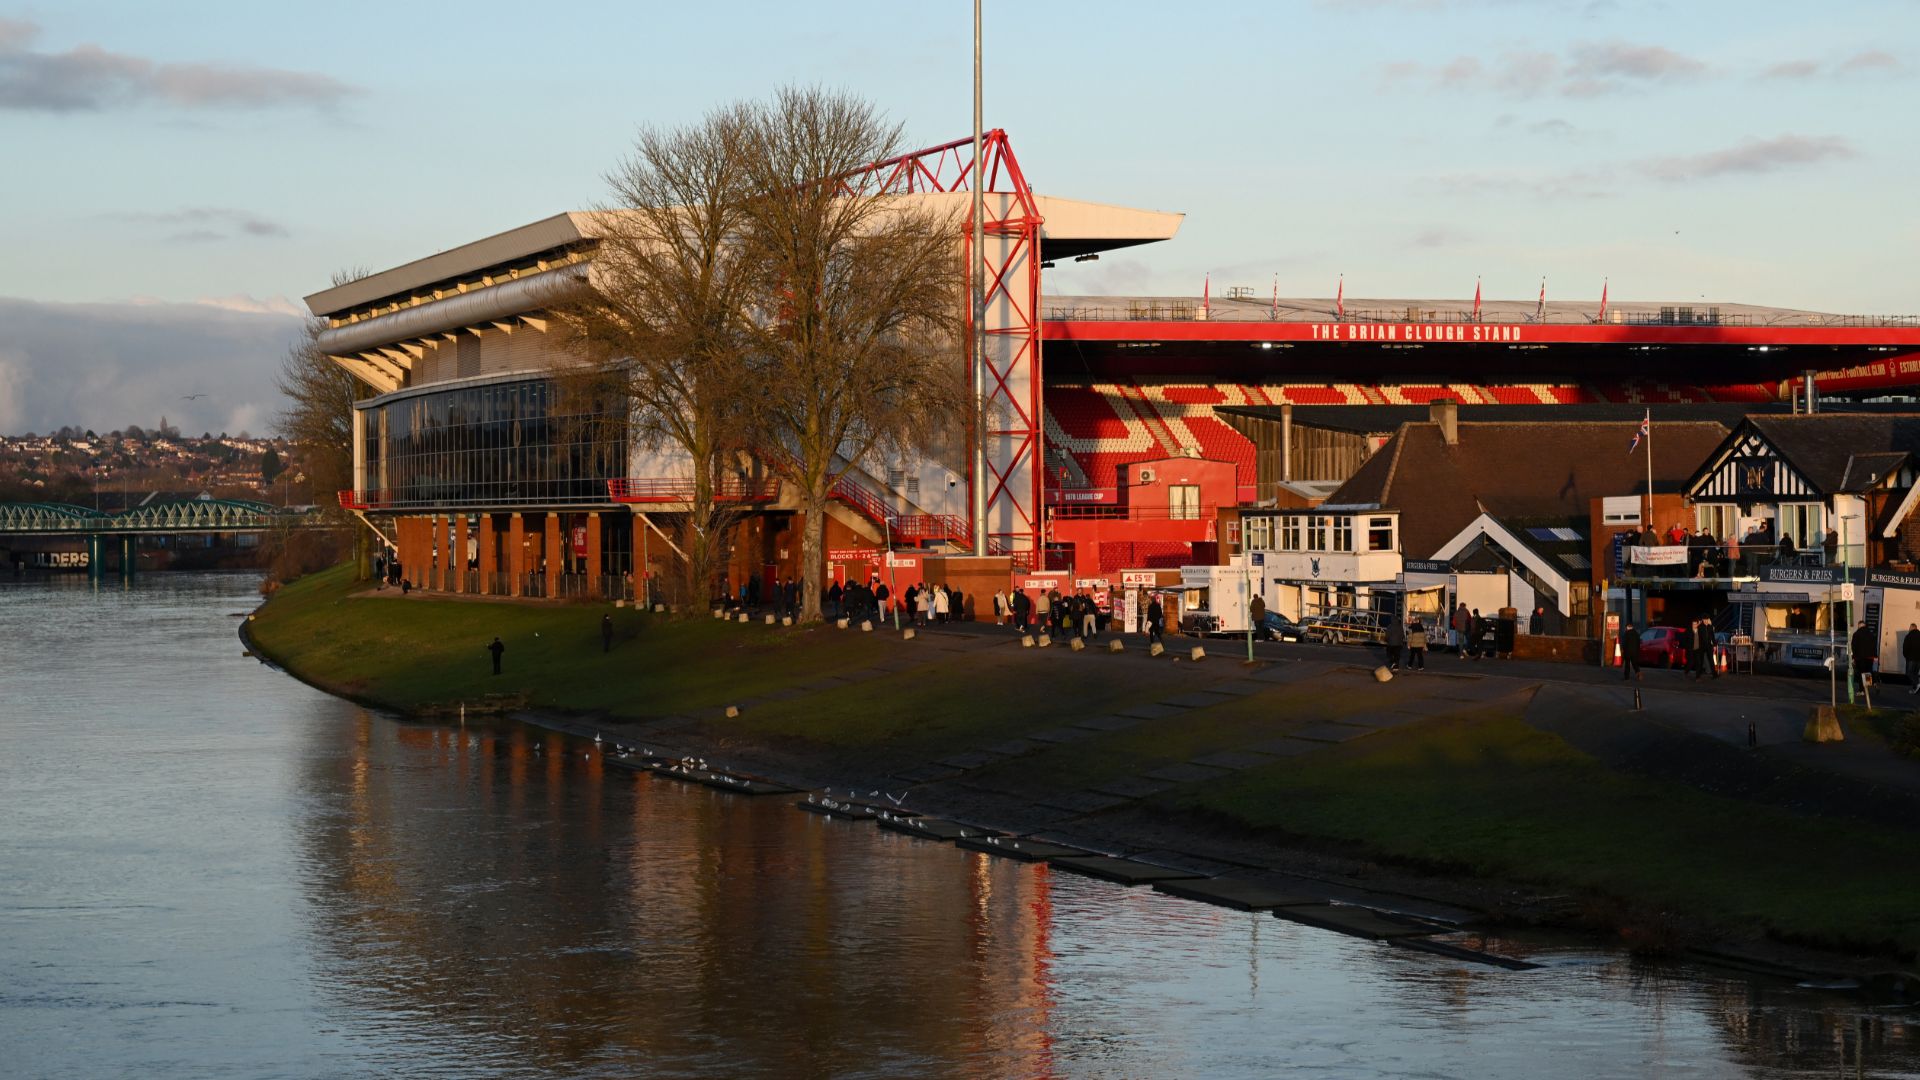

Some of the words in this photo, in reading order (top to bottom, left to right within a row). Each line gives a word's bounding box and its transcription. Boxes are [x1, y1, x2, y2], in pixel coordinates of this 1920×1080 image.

[1312, 325, 1339, 339] THE
[1349, 325, 1396, 340] BRIAN
[1405, 326, 1464, 340] CLOUGH
[1473, 326, 1520, 341] STAND
[1847, 365, 1871, 379] FOOTBALL
[1871, 363, 1886, 377] CLUB
[1093, 492, 1104, 500] CUP
[1769, 568, 1802, 580] BURGERS
[1803, 569, 1810, 579] &
[1811, 570, 1833, 580] FRIES
[1871, 573, 1900, 583] BURGERS
[1899, 575, 1905, 583] &
